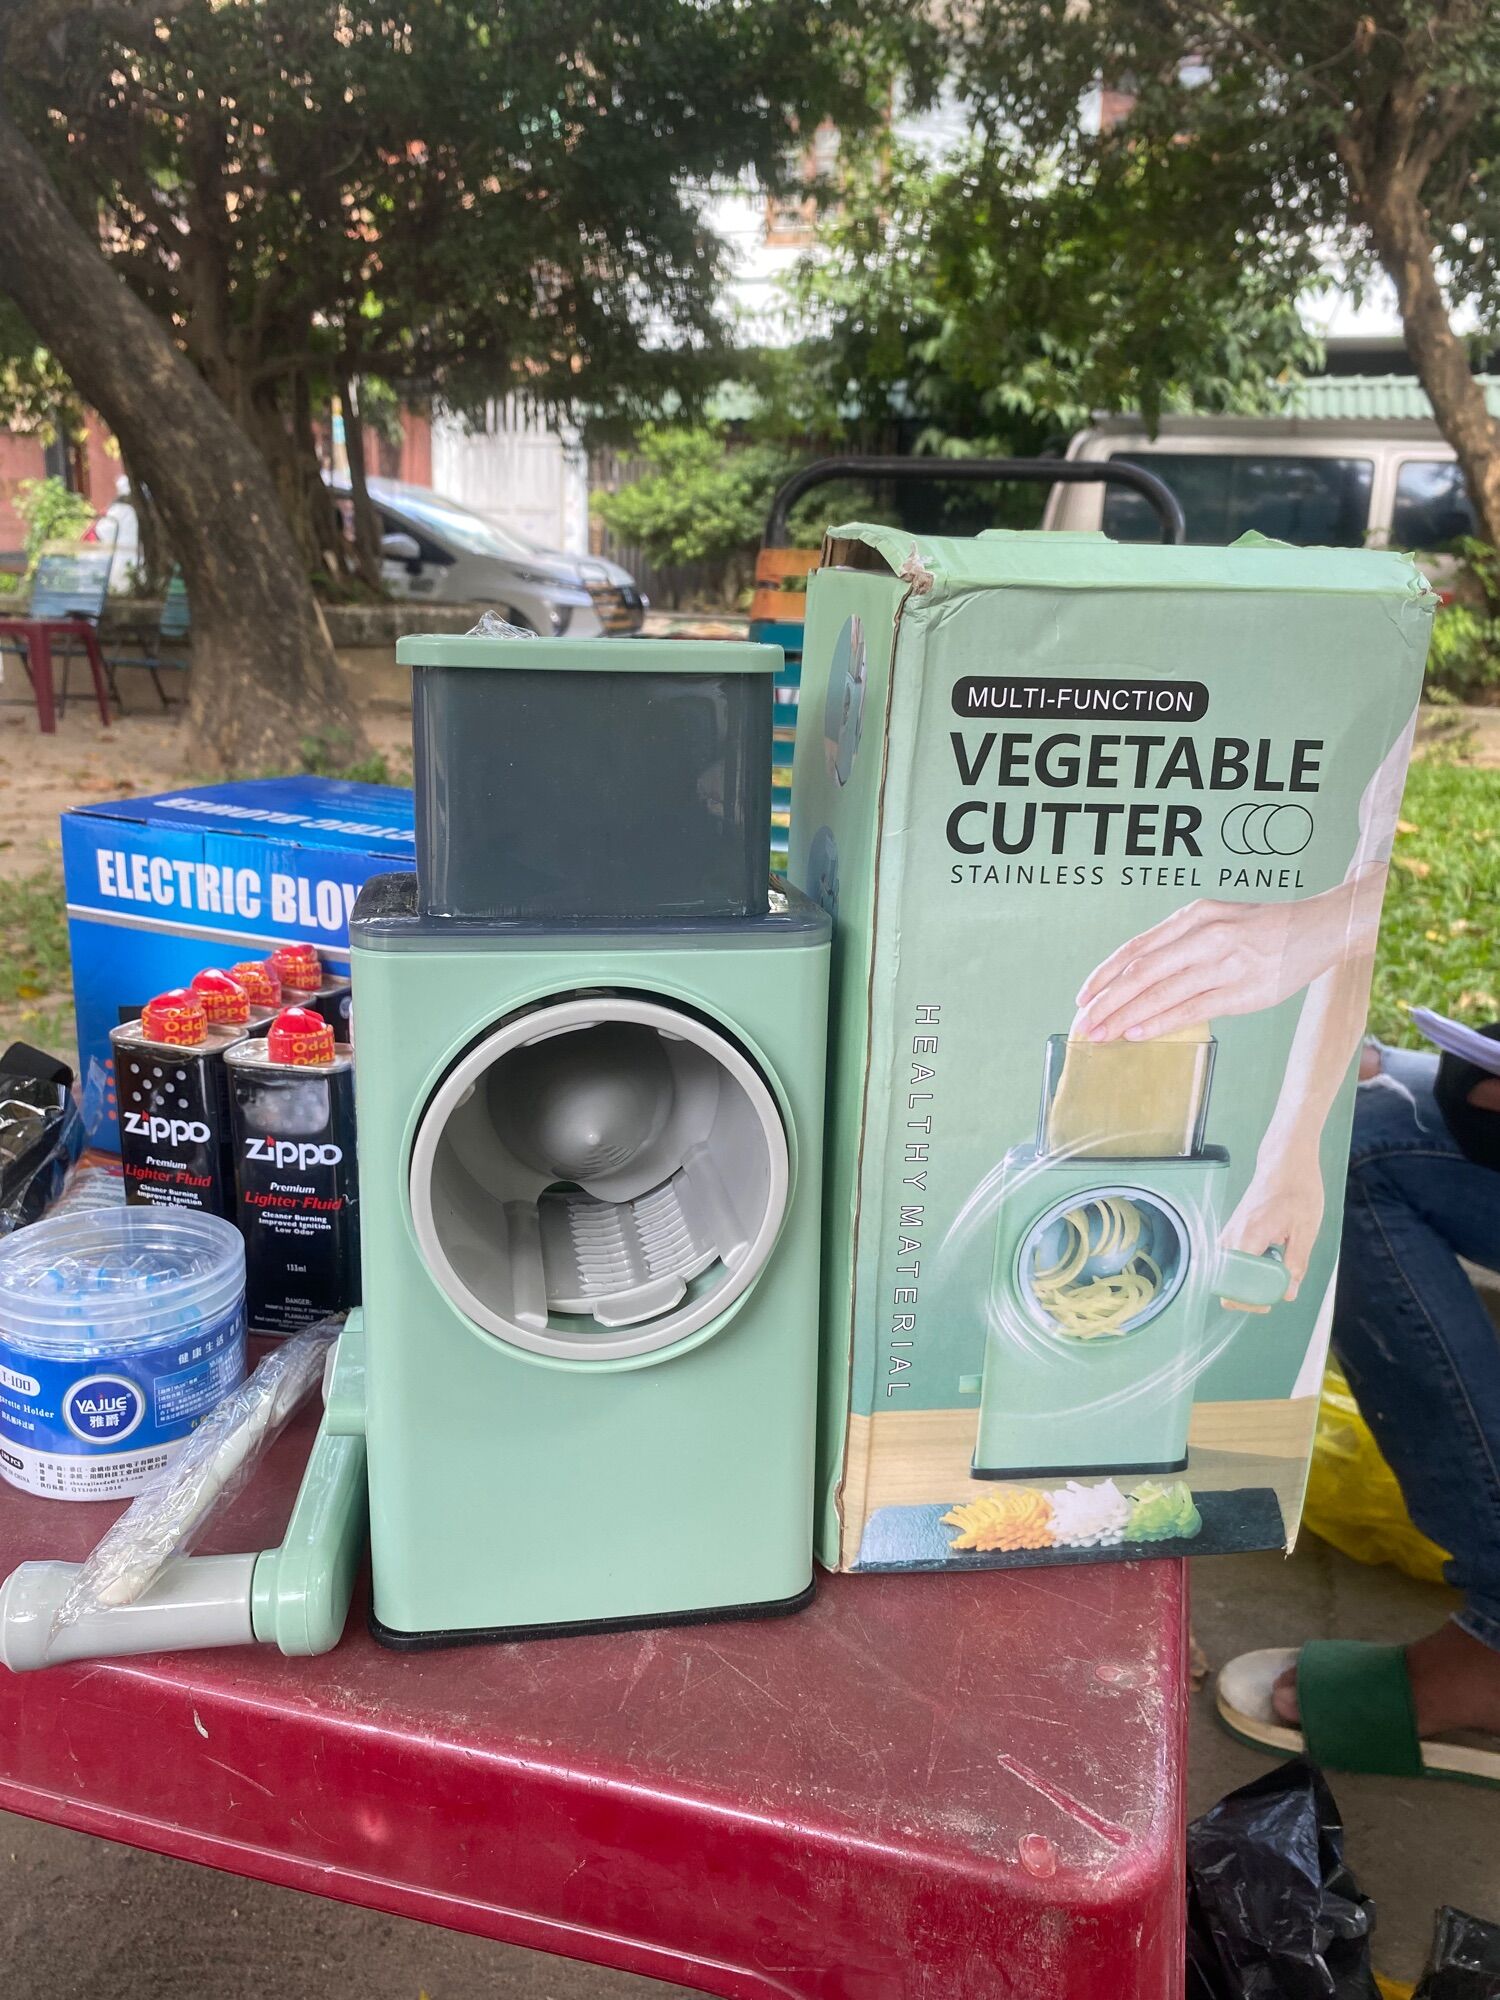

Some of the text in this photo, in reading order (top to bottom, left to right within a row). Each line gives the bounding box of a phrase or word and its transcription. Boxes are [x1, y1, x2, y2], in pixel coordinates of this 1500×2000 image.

[967, 686, 1194, 713] MULTI-FUNCTION
[949, 732, 1324, 792] VEGETABLE
[946, 800, 1204, 857] CUTTER
[96, 848, 262, 919] ELECTRIC
[950, 864, 1305, 888] STAINLESS STEEL PANEL
[146, 1156, 187, 1170] Premium
[126, 1164, 213, 1187] Lighter Fluid
[269, 1182, 316, 1194] Premium
[244, 1191, 344, 1211] Lighter Fluid
[886, 1003, 941, 1397] HEALTHY MATERIAL
[258, 1217, 332, 1231] Improved Ignition
[261, 1210, 328, 1224] Cleaner Burning
[275, 1226, 315, 1237] Low Odor
[23, 1404, 55, 1419] Holder
[75, 1395, 127, 1414] YAJUE
